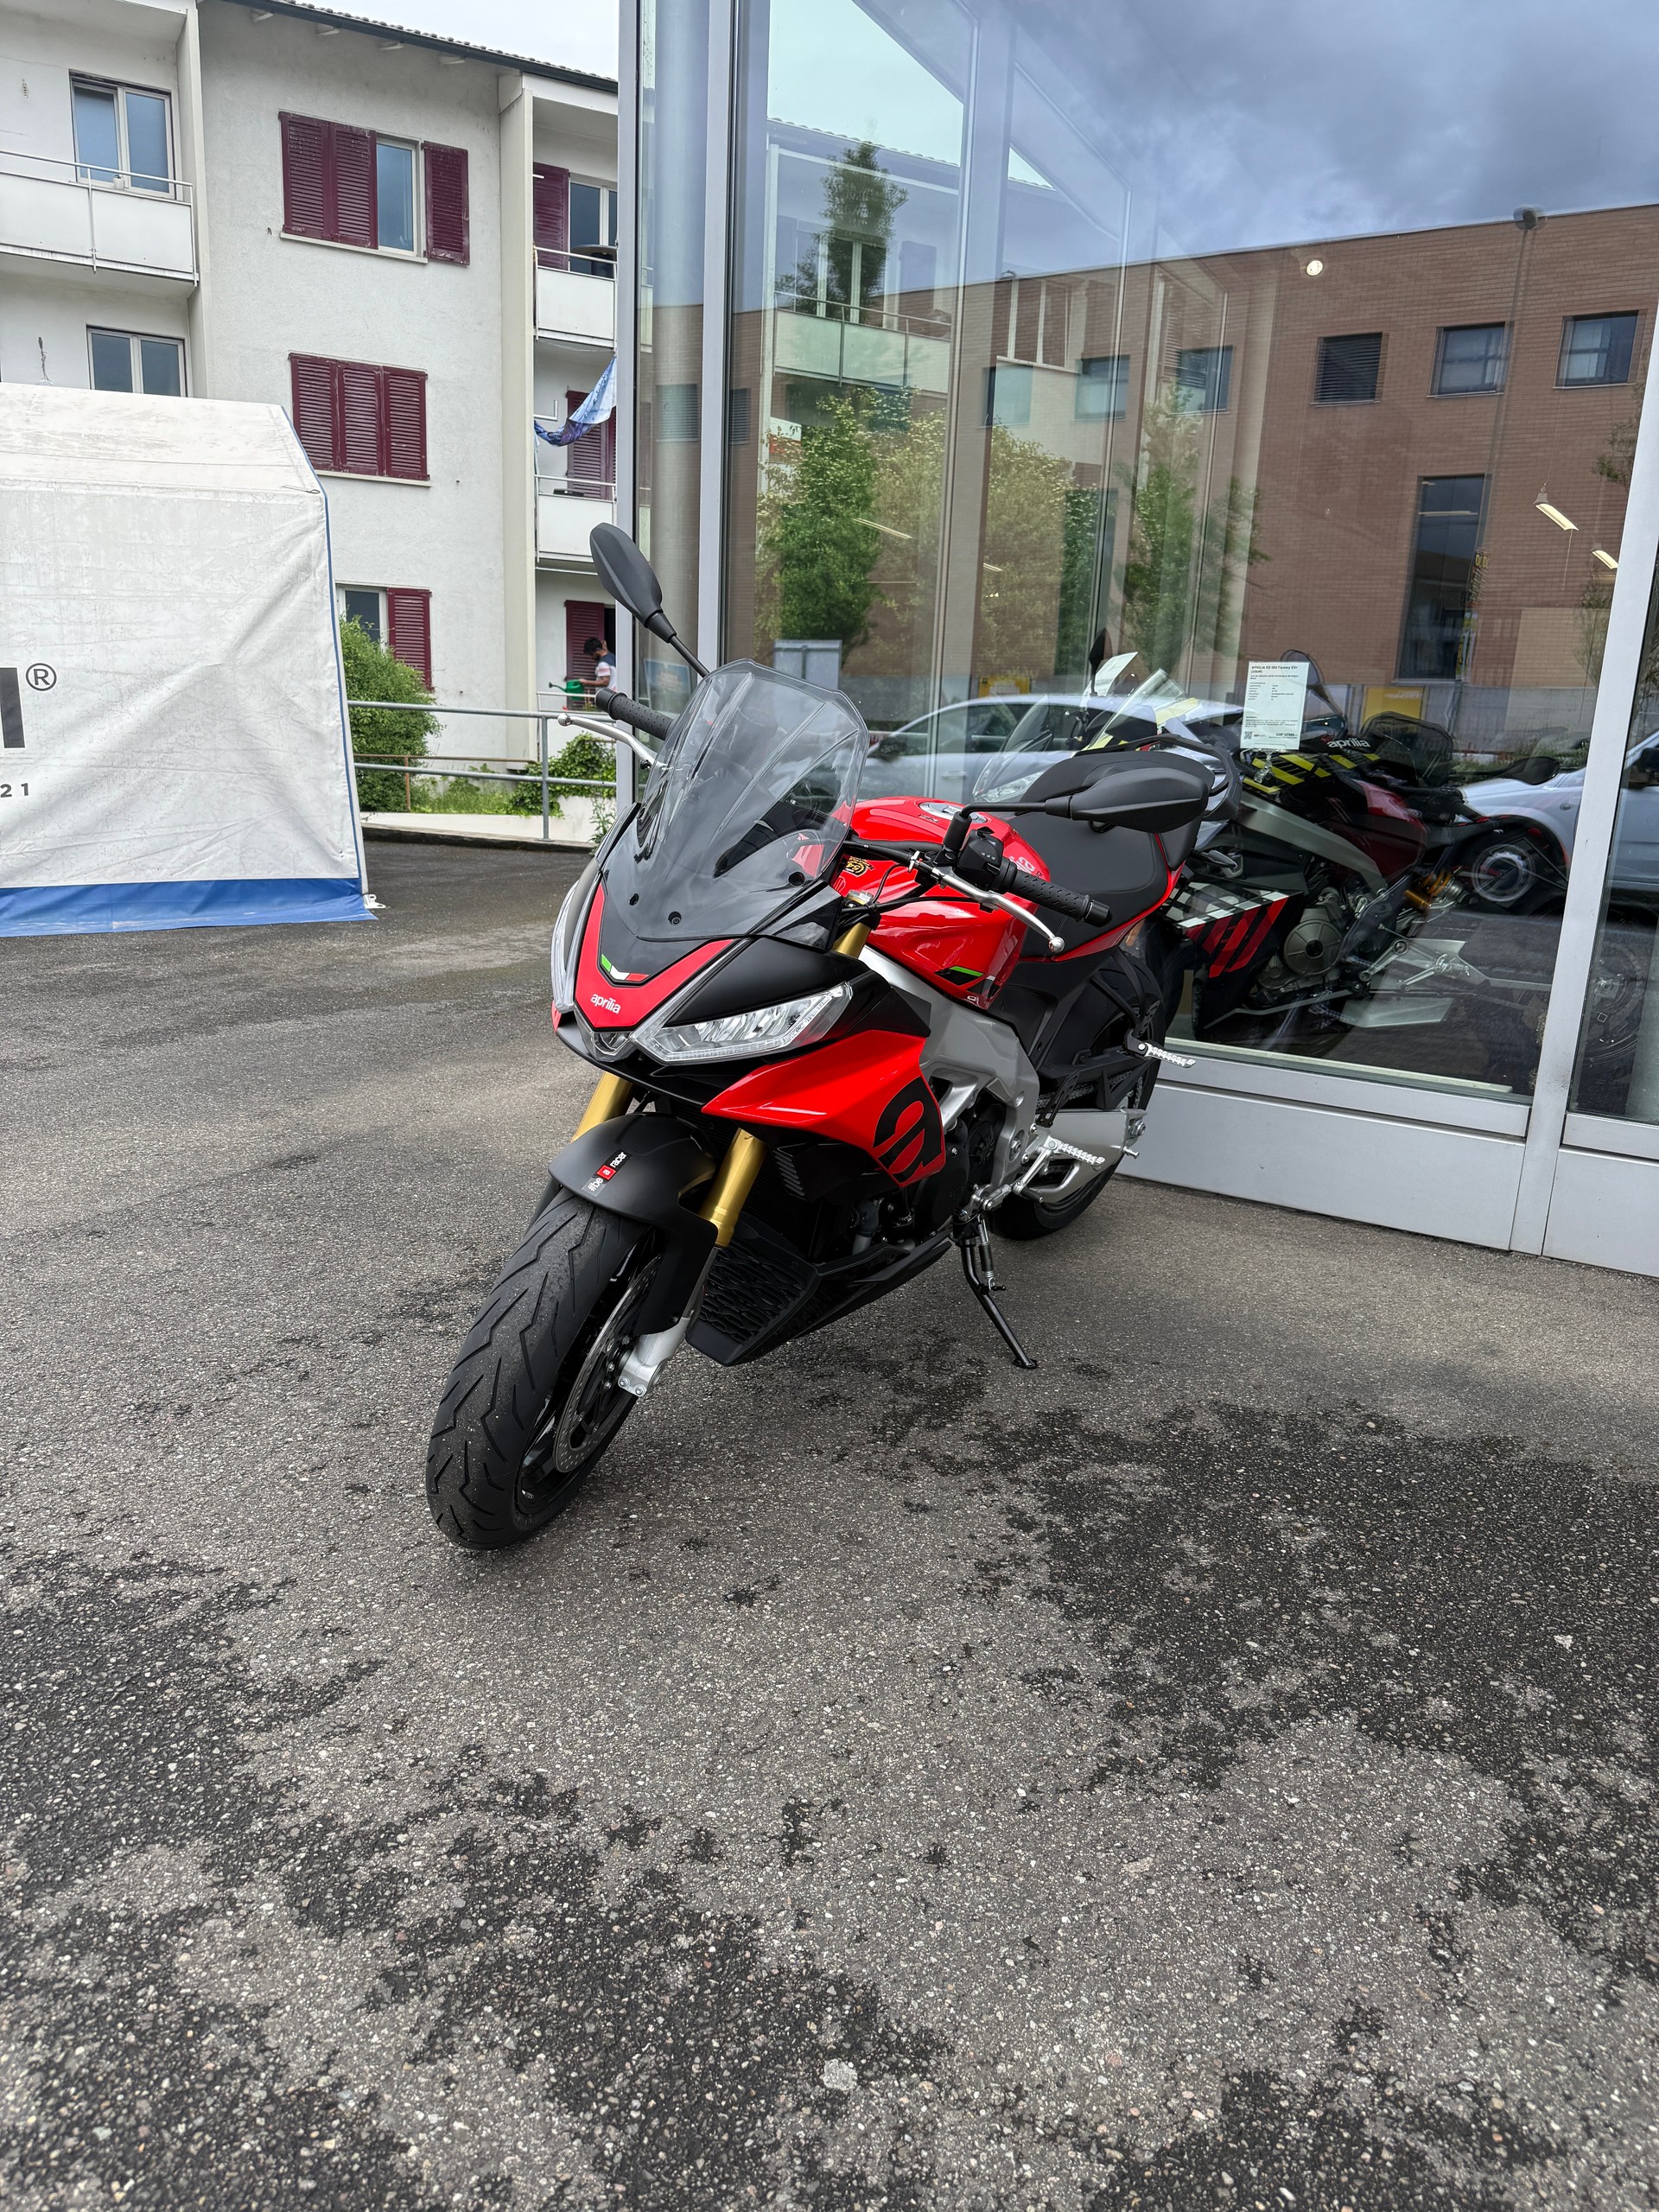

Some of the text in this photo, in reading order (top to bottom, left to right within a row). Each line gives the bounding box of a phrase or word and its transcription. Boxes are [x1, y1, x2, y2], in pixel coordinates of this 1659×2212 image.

[1326, 737, 1371, 749] aprilia
[590, 994, 621, 1014] aprilia
[588, 1177, 603, 1192] #be
[609, 1151, 627, 1168] racer
